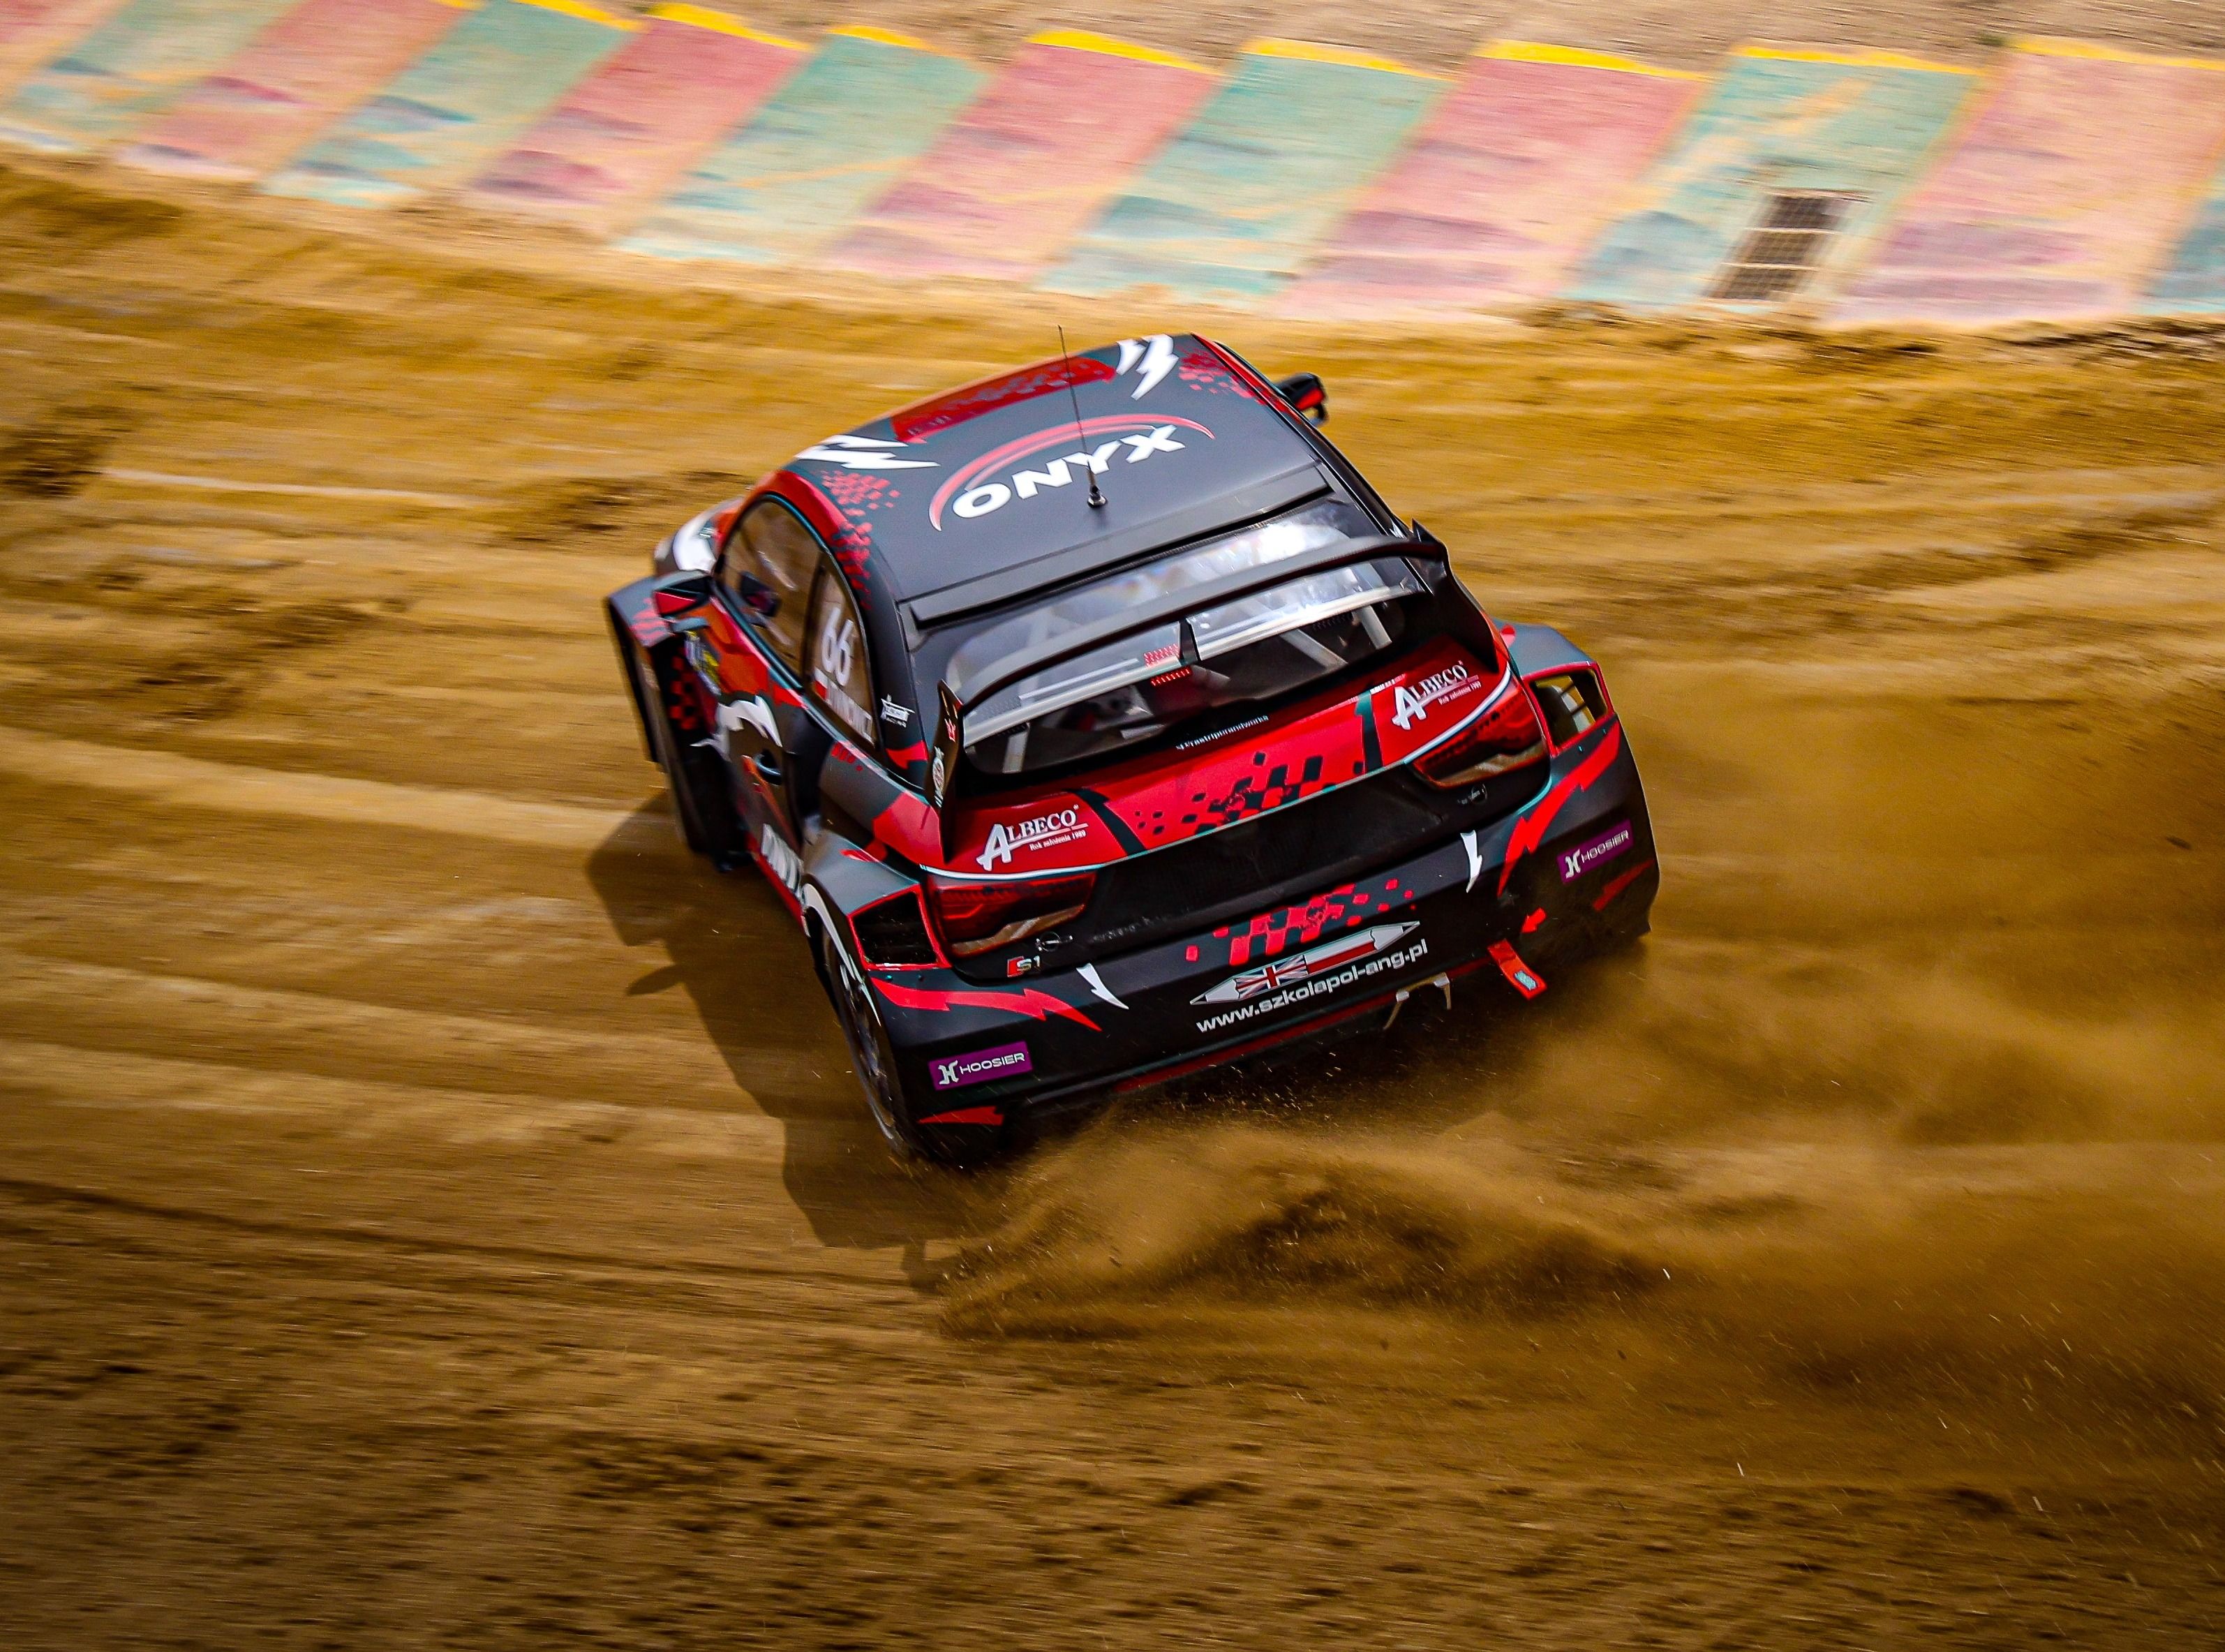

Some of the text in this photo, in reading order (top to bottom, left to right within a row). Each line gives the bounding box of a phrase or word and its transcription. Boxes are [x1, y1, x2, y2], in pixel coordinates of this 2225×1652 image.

[952, 424, 1186, 519] ONYX
[976, 810, 1077, 871] ALBECO
[1581, 829, 1630, 863] HOOSIER
[1196, 939, 1428, 1033] www.szkolapol-ang.pl
[960, 1052, 1025, 1075] HOOSIER
